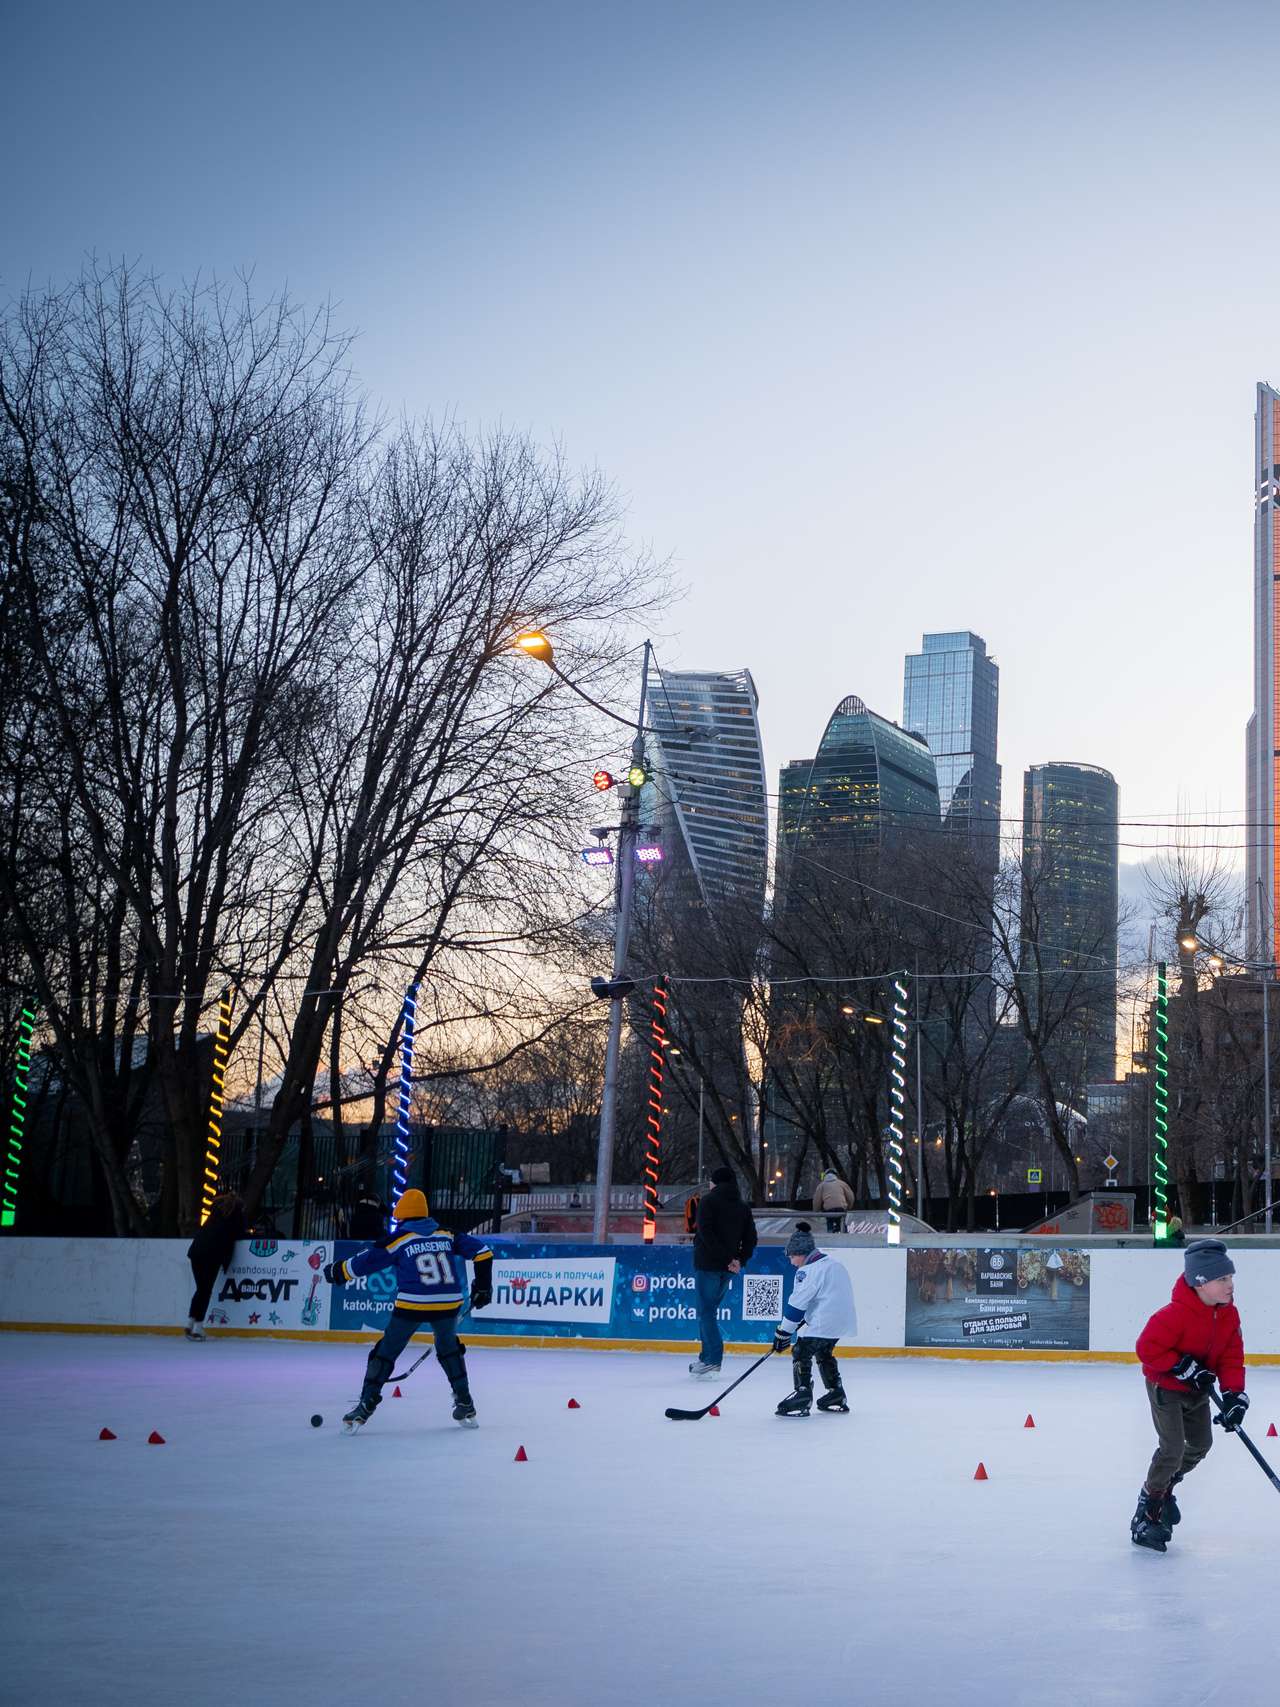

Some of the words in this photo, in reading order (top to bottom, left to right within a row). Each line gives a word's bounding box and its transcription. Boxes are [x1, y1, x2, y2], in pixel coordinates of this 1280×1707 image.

[415, 1251, 455, 1286] 91
[497, 1269, 553, 1280] ПОДПИШИСЬ
[555, 1271, 561, 1280] И
[563, 1270, 605, 1281] ПОЛУЧАЙ
[218, 1278, 299, 1303] ДОСУГ
[650, 1273, 733, 1292] proka
[496, 1284, 604, 1307] ПОДАРКИ
[649, 1304, 732, 1323] prokan
[963, 1320, 988, 1329] ОТДЫХ
[995, 1313, 1028, 1324] ПОЛЬЗОЙ
[970, 1325, 985, 1335] ДЛЯ
[985, 1322, 1023, 1333] ЗДОРОВЬЯ
